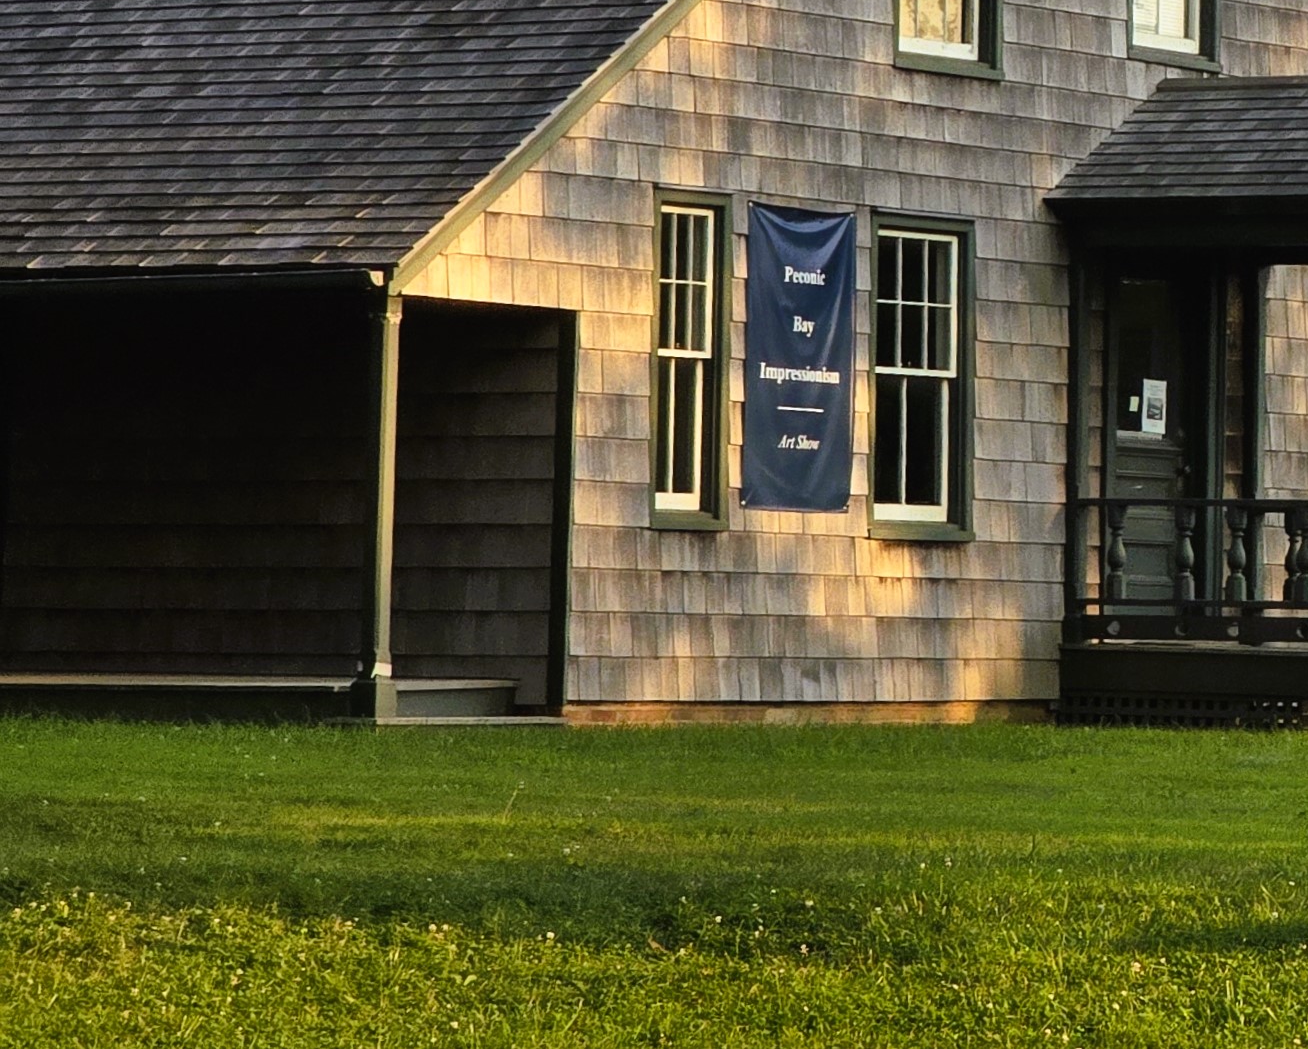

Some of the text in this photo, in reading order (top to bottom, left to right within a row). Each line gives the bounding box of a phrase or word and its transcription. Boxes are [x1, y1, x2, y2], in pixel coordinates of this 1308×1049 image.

[784, 265, 826, 286] Peconic
[793, 315, 816, 338] Bay
[759, 361, 840, 385] Impressionism
[777, 434, 821, 450] Art Show
